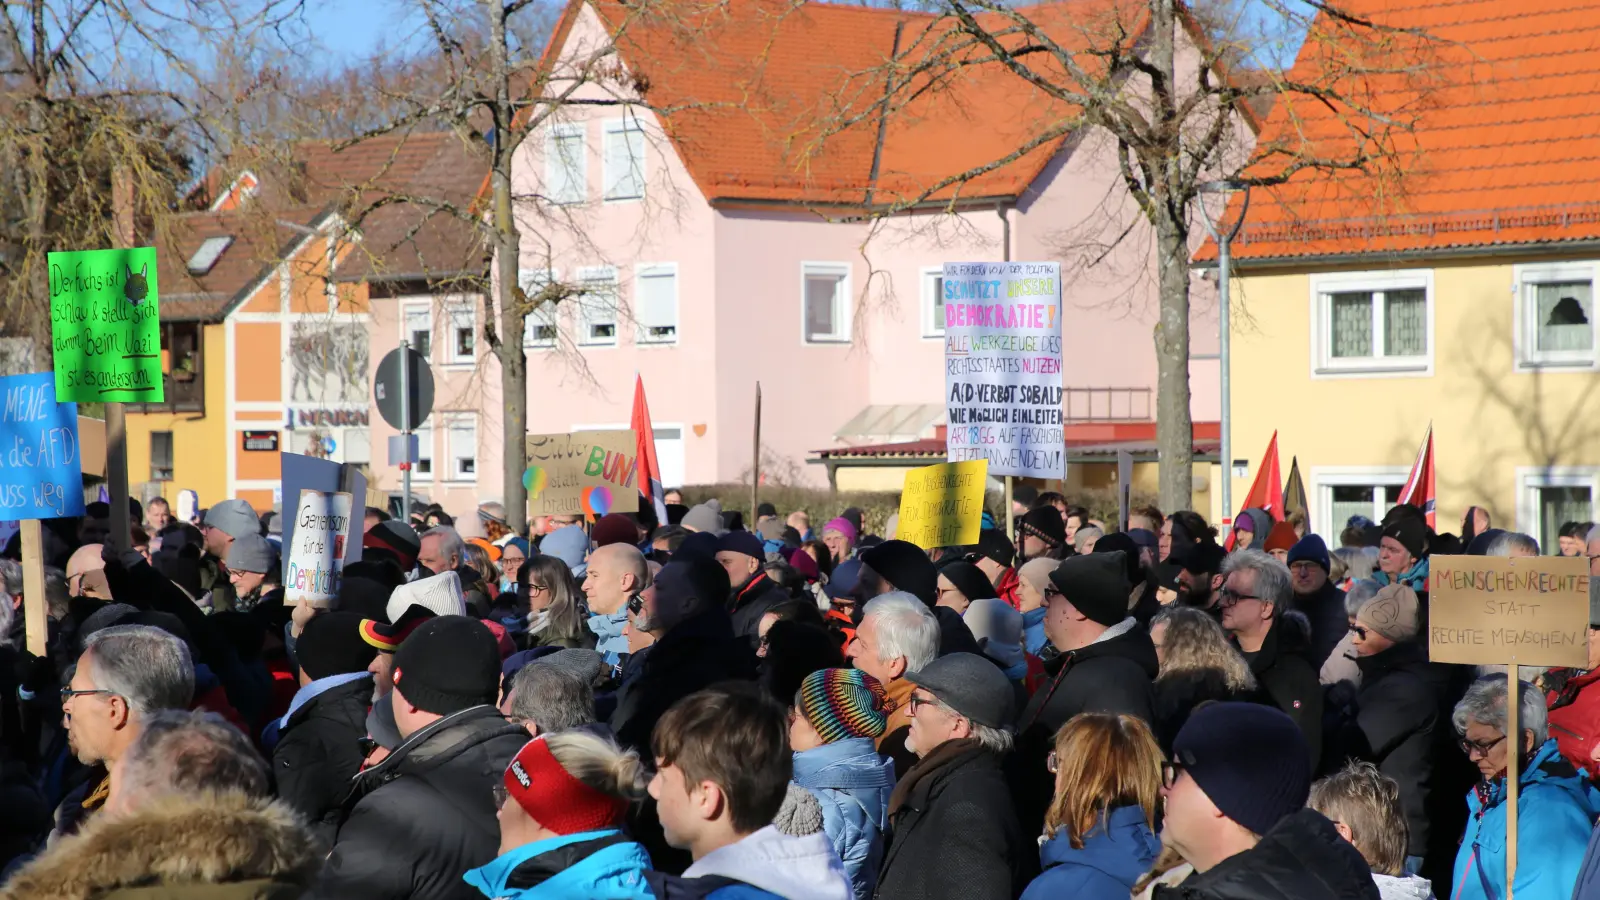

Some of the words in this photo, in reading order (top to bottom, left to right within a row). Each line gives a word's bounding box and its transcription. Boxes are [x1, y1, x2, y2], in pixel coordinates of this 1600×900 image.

[52, 263, 73, 297] Der
[75, 261, 102, 293] Fuchs
[106, 268, 119, 288] ist
[53, 298, 88, 324] schlau
[92, 301, 98, 321] &
[102, 299, 129, 323] stellt
[132, 300, 156, 325] sich
[84, 327, 121, 356] Beim
[125, 328, 151, 354] Nazi
[946, 335, 969, 353] ALLE
[971, 335, 1039, 352] WERKZEUGE
[1041, 336, 1061, 353] DES
[61, 361, 81, 388] ist
[947, 357, 1020, 375] RECHTSSTAATES
[1022, 357, 1060, 373] NUTZEN
[1019, 385, 1063, 405] SOBALD
[949, 408, 966, 423] WIE
[1012, 408, 1063, 425] EINLEITEN
[527, 433, 588, 462] Lieber
[998, 427, 1018, 444] AUF
[1021, 427, 1064, 444] FASCHISTEN
[8, 435, 34, 468] die
[32, 480, 65, 516] weg
[1436, 569, 1589, 593] MENSCHENRECHTE
[1484, 600, 1540, 616] STATT
[1432, 626, 1484, 646] RECHTE
